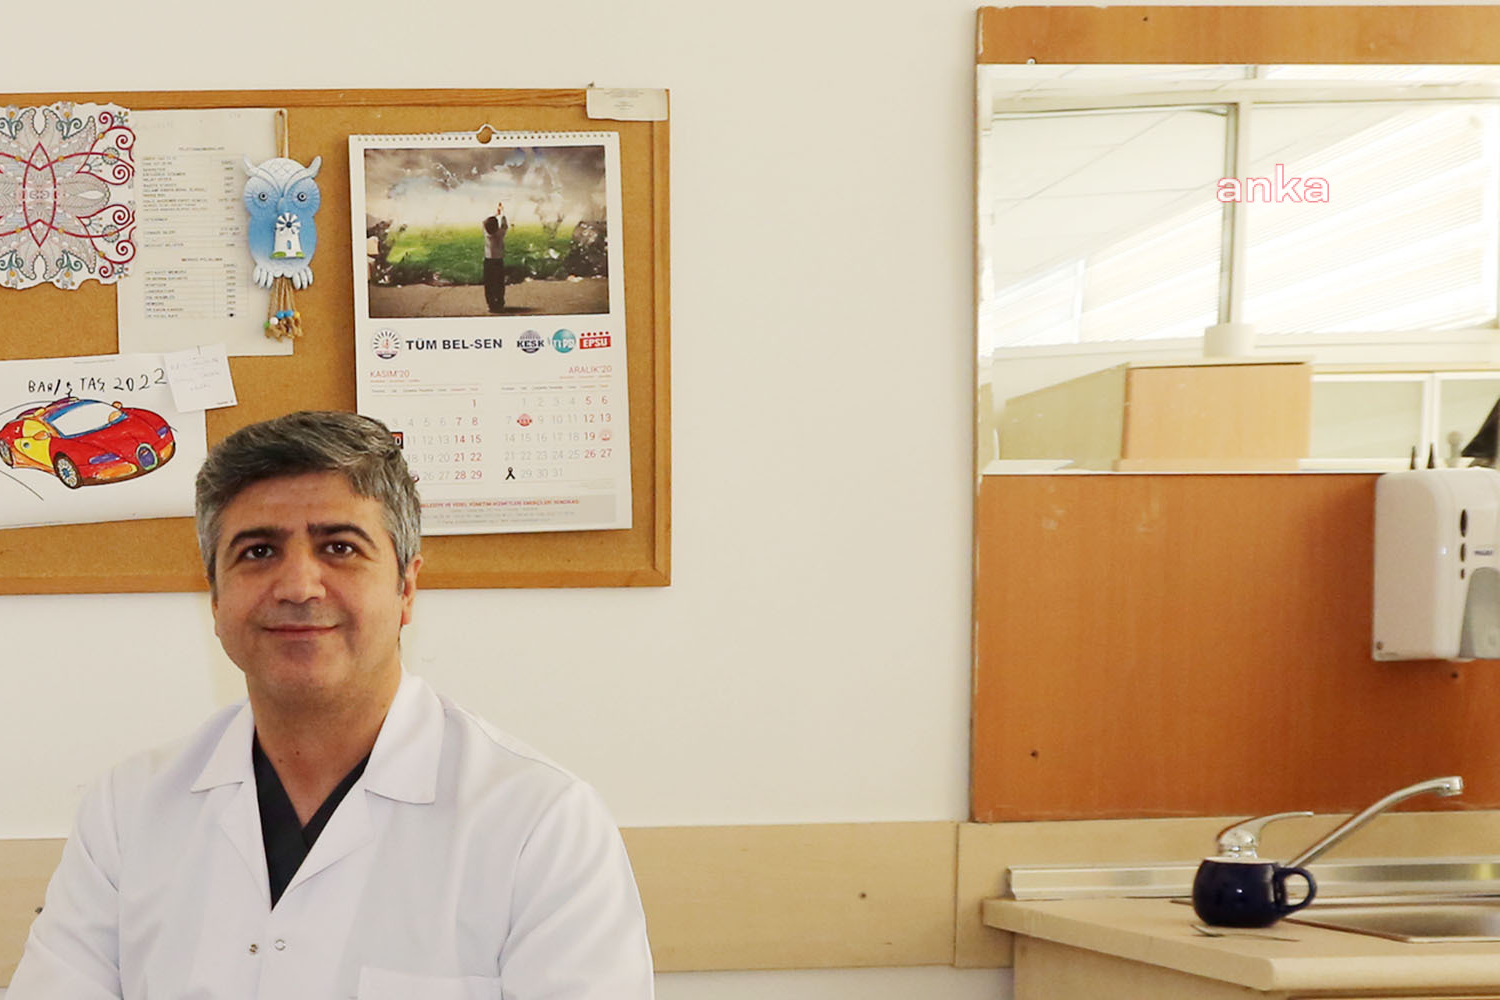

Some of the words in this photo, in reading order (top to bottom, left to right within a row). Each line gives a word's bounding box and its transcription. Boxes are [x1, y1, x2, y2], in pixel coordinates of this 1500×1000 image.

[405, 338, 437, 350] TÜM
[442, 338, 502, 350] BEL-SEN
[516, 340, 544, 348] KESK
[583, 337, 608, 348] EPSU
[113, 368, 168, 392] 2022
[584, 413, 595, 423] 12
[600, 412, 612, 423] 13
[455, 434, 466, 444] 14
[471, 434, 482, 443] 15
[584, 431, 596, 441] 19
[454, 452, 464, 462] 21
[470, 452, 482, 462] 22
[584, 449, 596, 459] 26
[600, 448, 612, 458] 27
[455, 470, 466, 480] 28
[471, 470, 482, 479] 29
